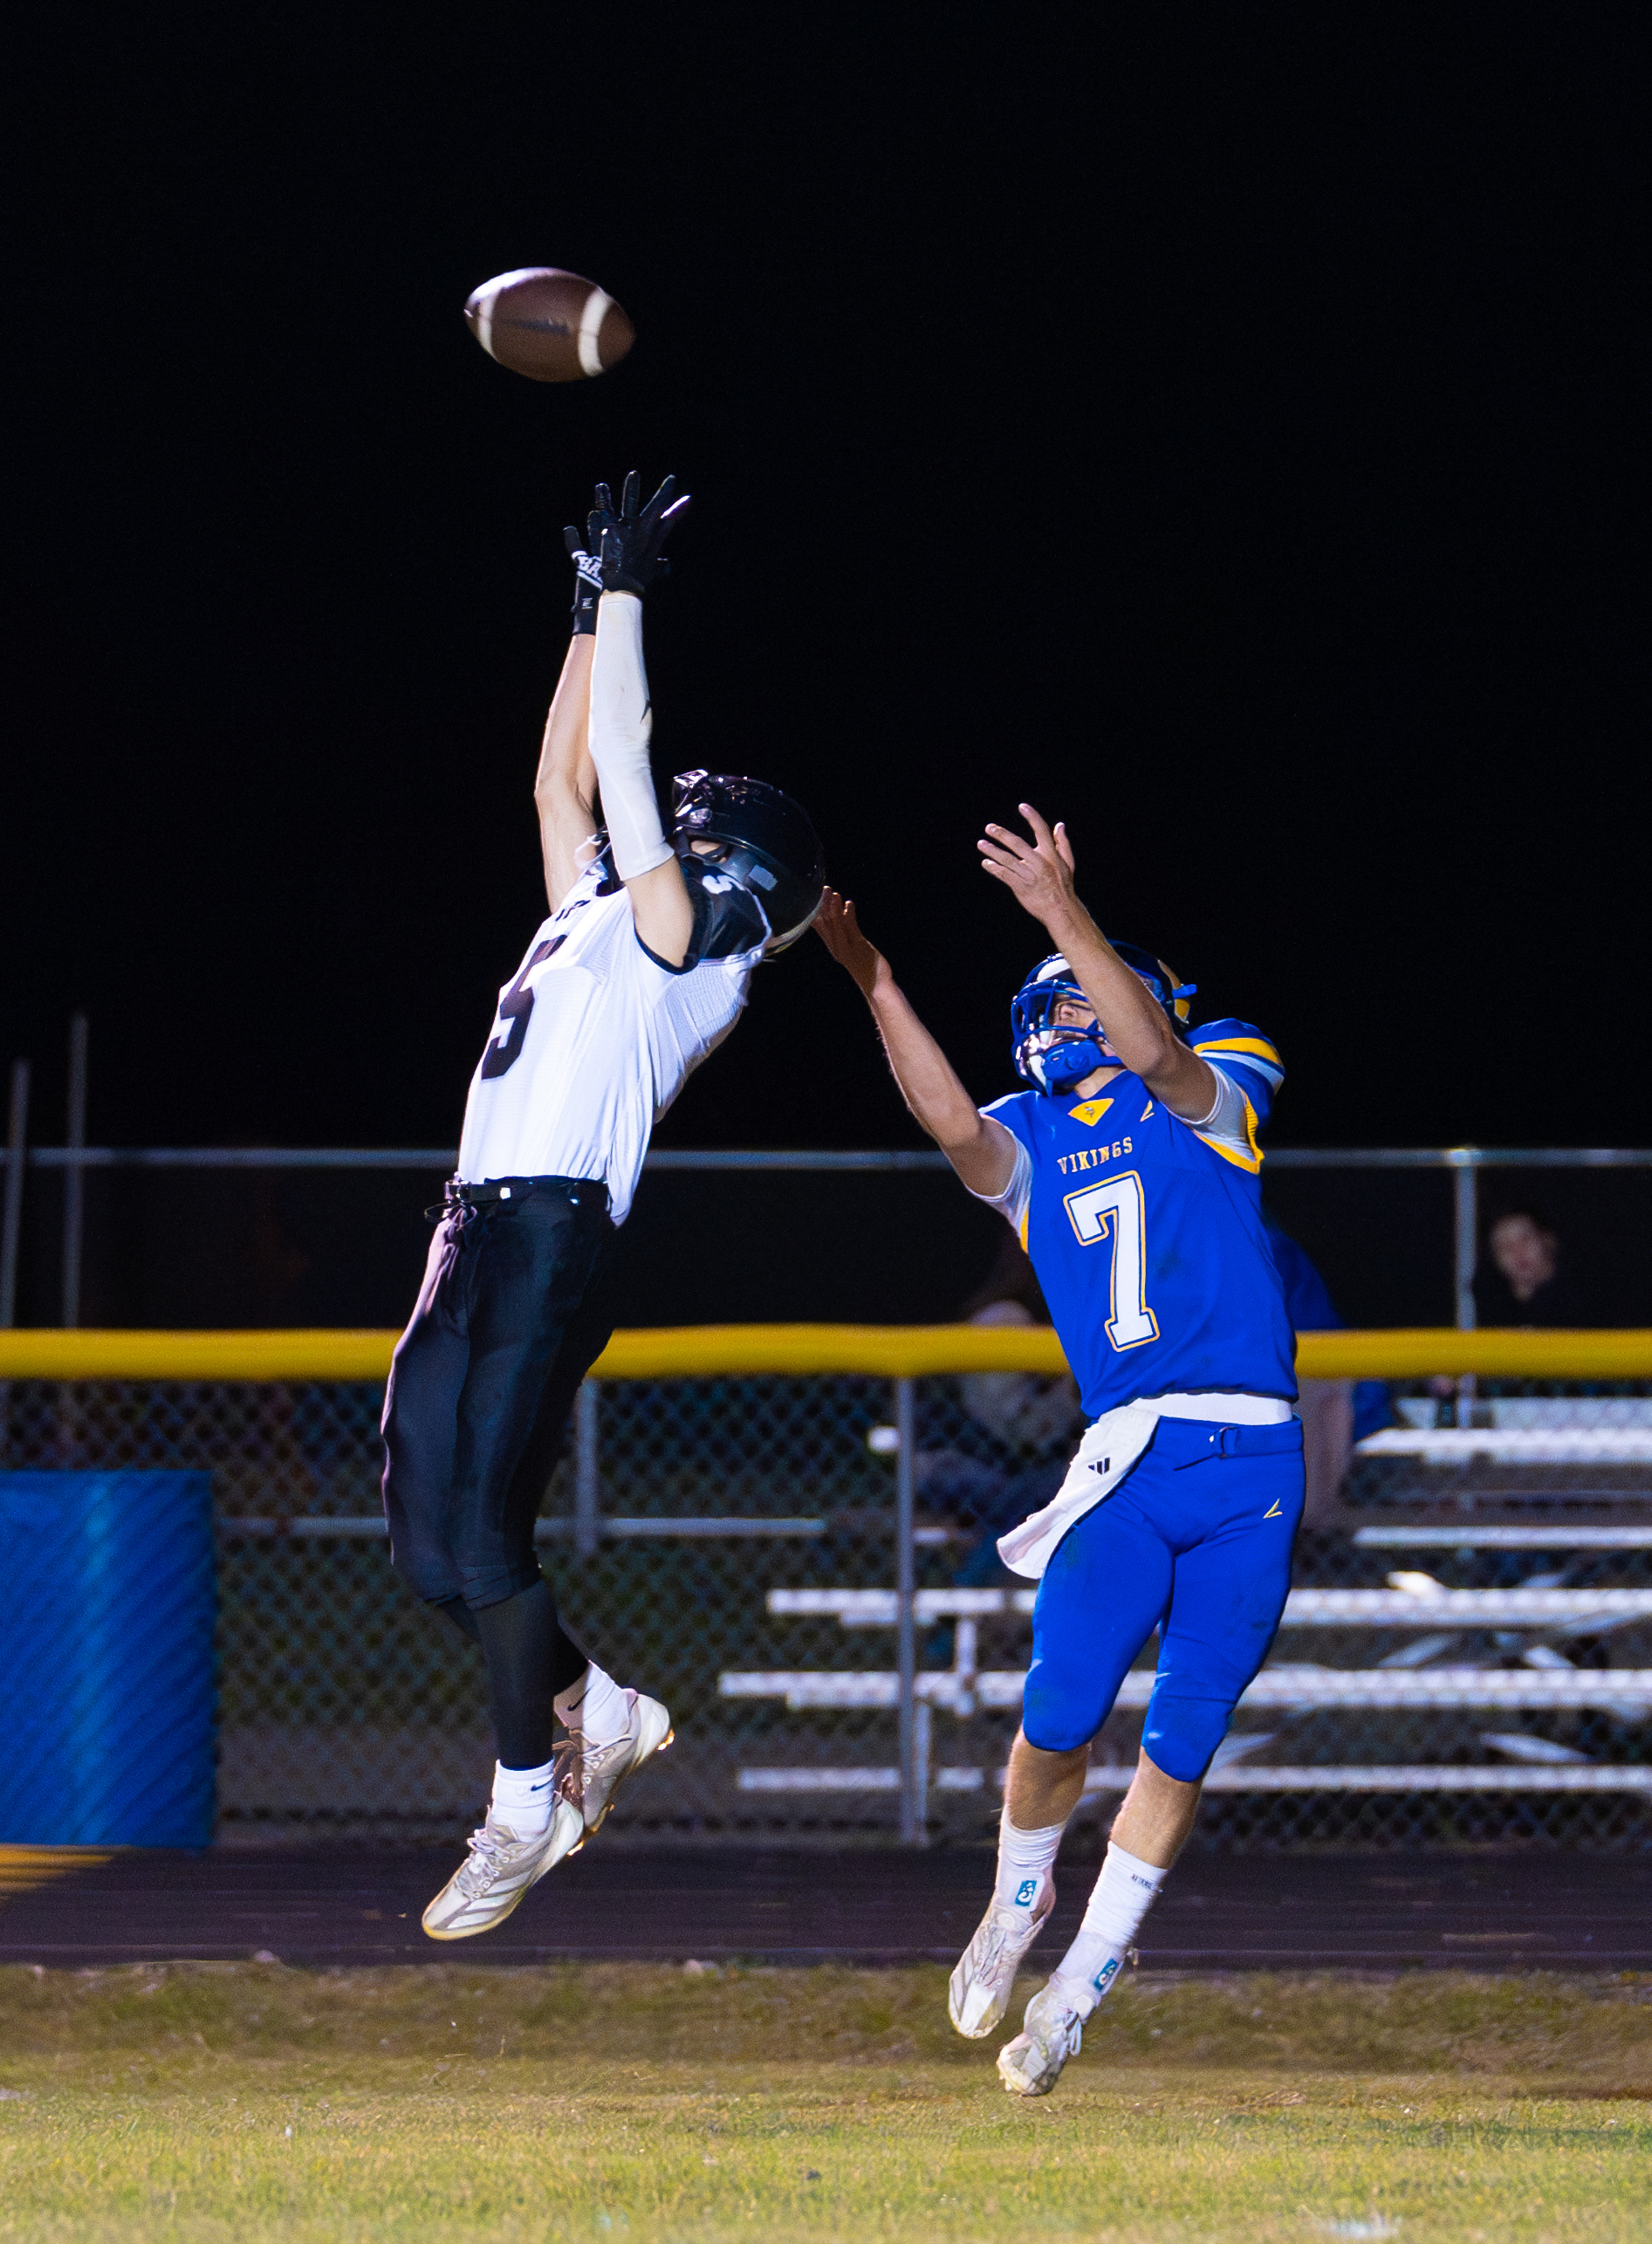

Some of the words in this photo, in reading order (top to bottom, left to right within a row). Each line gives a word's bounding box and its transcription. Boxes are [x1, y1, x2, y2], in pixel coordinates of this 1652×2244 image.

[481, 934, 568, 1081] 5
[1057, 1136, 1133, 1175] VIKINGS
[1064, 1170, 1160, 1352] 7
